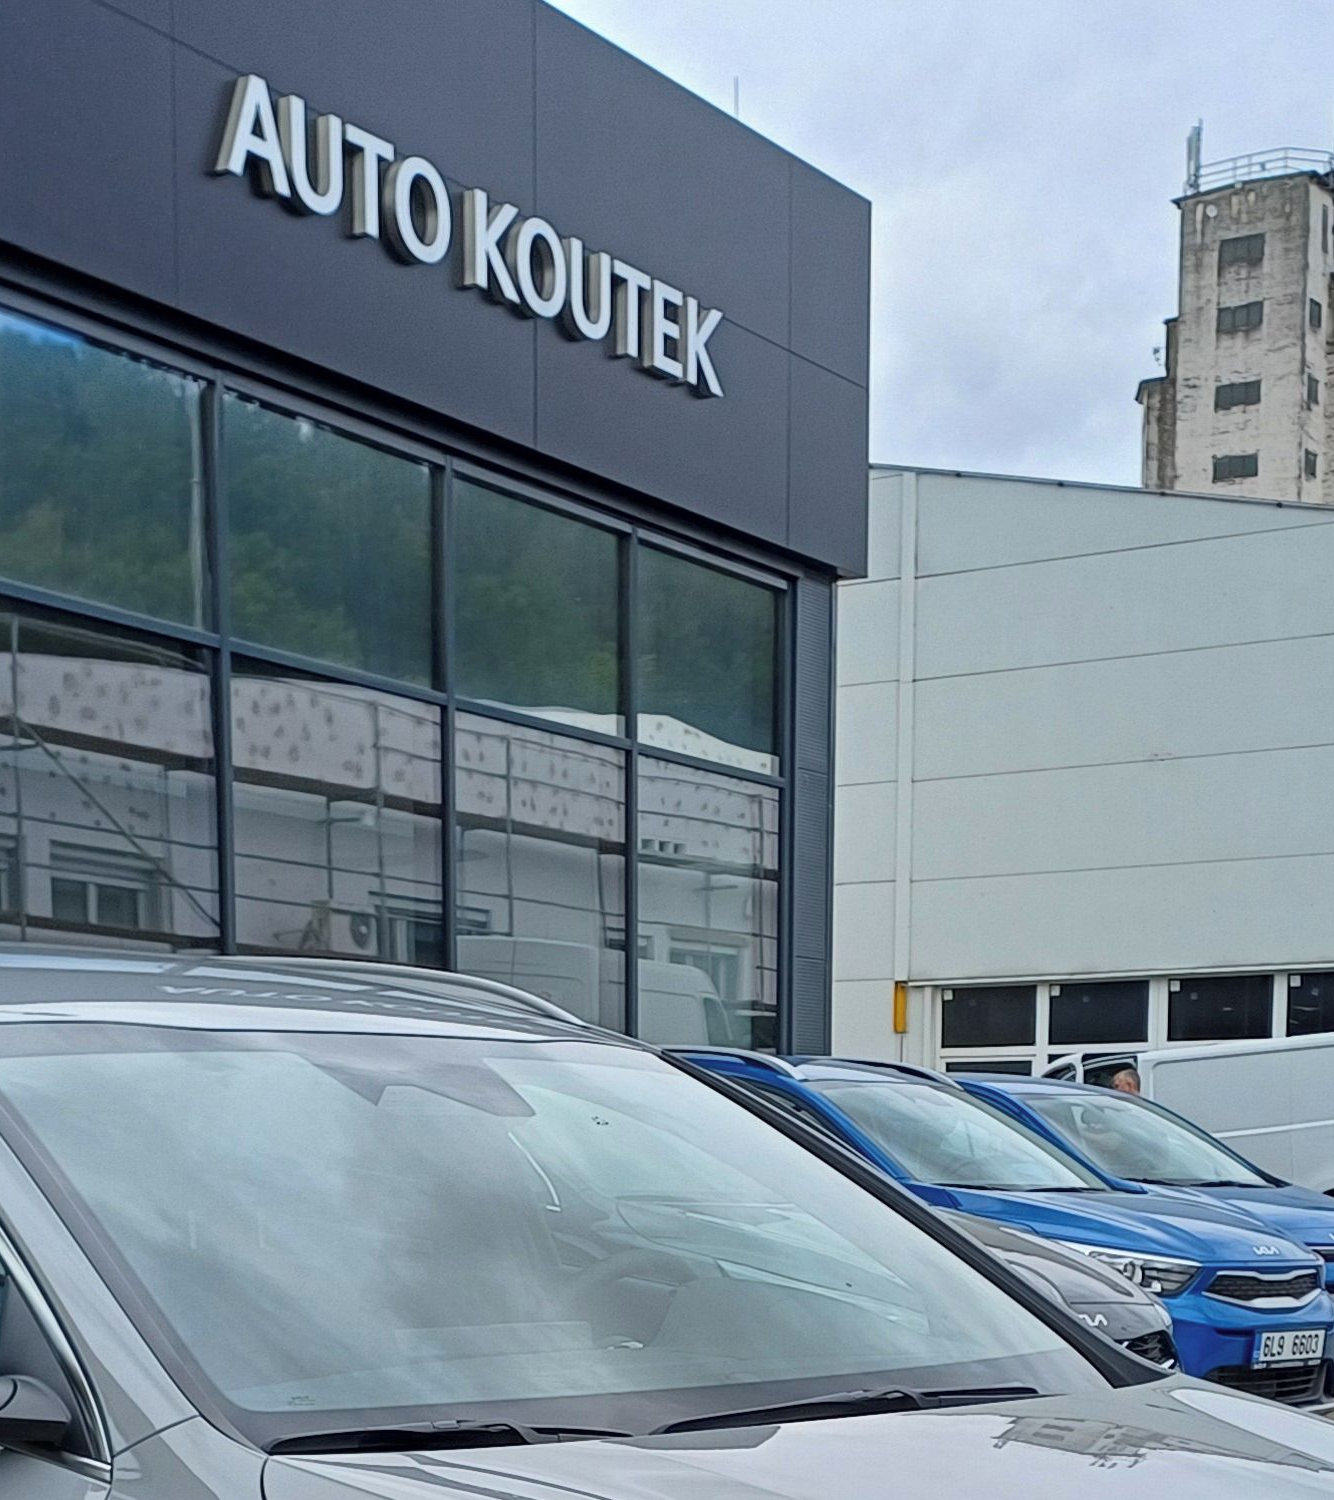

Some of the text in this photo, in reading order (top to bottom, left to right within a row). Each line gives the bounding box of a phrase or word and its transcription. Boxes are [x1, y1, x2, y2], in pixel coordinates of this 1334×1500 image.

[215, 73, 724, 399] AUTO KOUTEK
[1253, 1246, 1280, 1256] KIA
[1263, 1334, 1319, 1357] 6L9 6603
